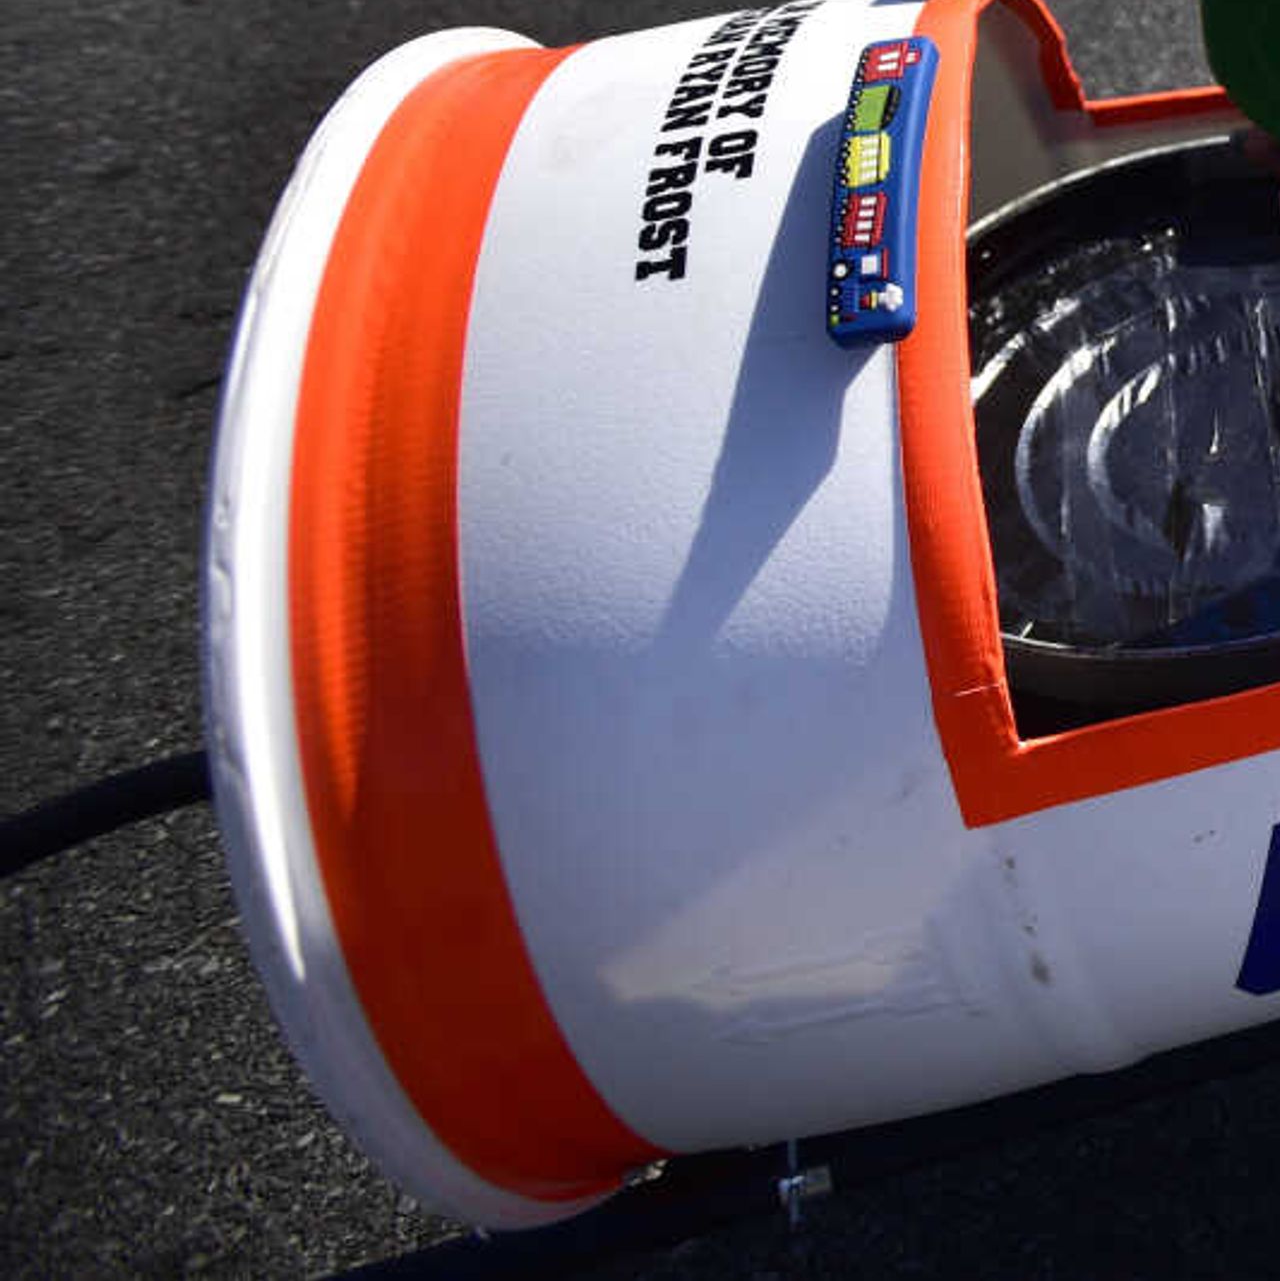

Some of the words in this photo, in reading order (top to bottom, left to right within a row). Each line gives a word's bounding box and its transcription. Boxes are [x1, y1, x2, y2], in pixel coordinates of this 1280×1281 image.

[661, 47, 738, 132] RYAN
[716, 13, 808, 119] MEMORY
[704, 129, 759, 179] OF
[635, 136, 704, 281] FROST
